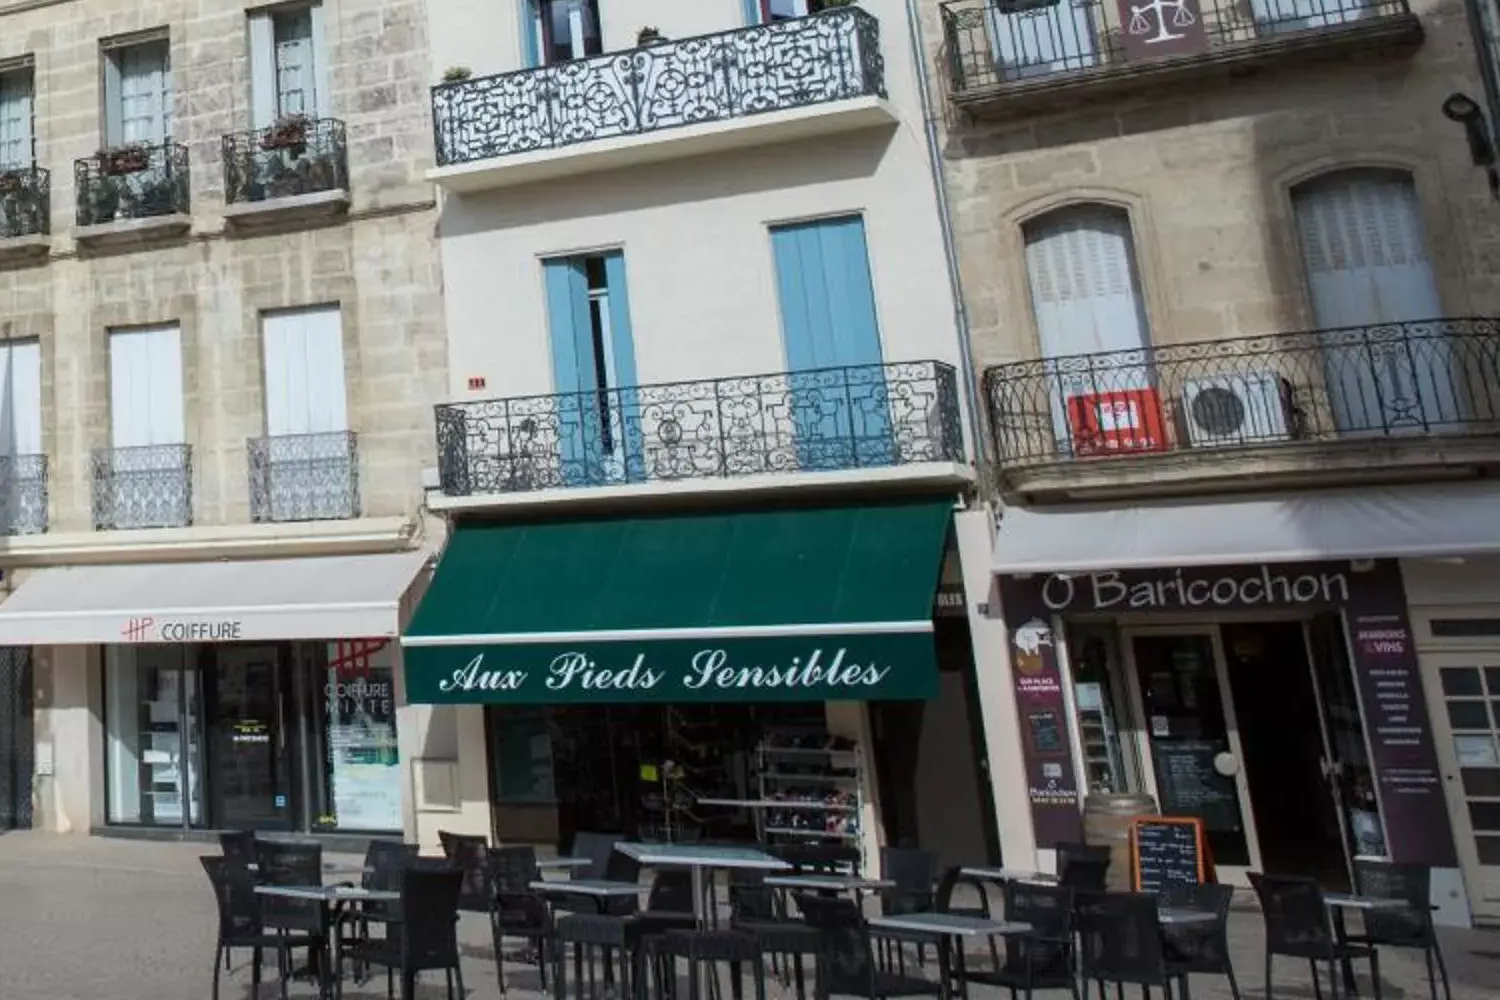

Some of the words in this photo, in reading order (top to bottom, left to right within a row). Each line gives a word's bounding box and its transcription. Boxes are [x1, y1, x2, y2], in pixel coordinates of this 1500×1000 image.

[1091, 564, 1350, 609] Baricochon
[161, 621, 243, 642] COIFFURE
[438, 652, 529, 692] Aux
[545, 650, 666, 691] Pieds
[682, 647, 892, 689] Sensibles
[323, 682, 390, 698] COIFFURE
[324, 699, 390, 714] MIXTE
